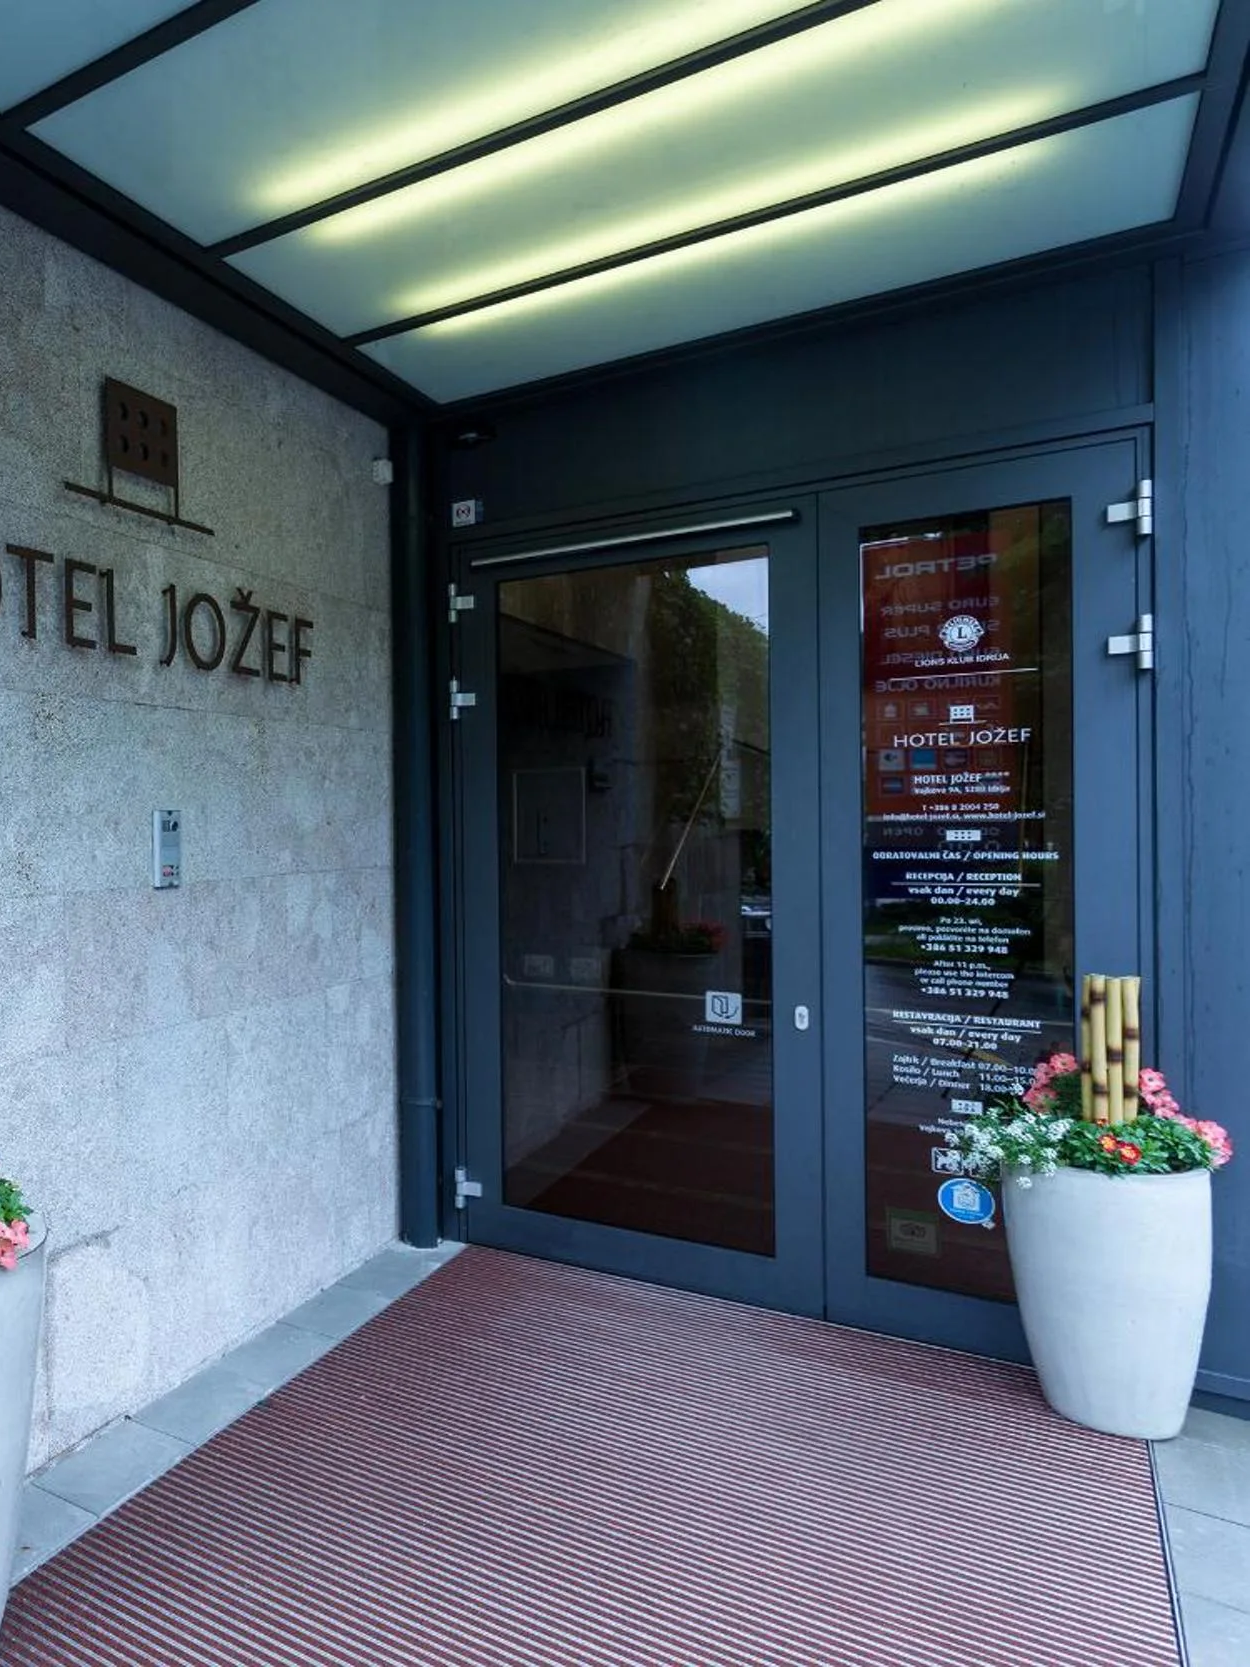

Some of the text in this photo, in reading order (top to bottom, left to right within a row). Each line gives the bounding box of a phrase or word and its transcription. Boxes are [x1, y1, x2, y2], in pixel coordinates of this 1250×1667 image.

[159, 584, 314, 686] JOŽEF
[915, 658, 944, 667] LIONS
[894, 727, 1031, 748] HOTEL JOŽEF
[914, 772, 982, 784] HOTEL JOŽEF
[942, 851, 961, 859] ČAS
[966, 873, 1022, 881] RECEPTION
[966, 889, 995, 897] every
[999, 888, 1019, 897] day
[974, 1016, 1041, 1029] RESTAURANT
[910, 1026, 934, 1035] vsak
[937, 1028, 956, 1036] dan
[968, 1032, 998, 1041] every
[1001, 1032, 1021, 1043] day
